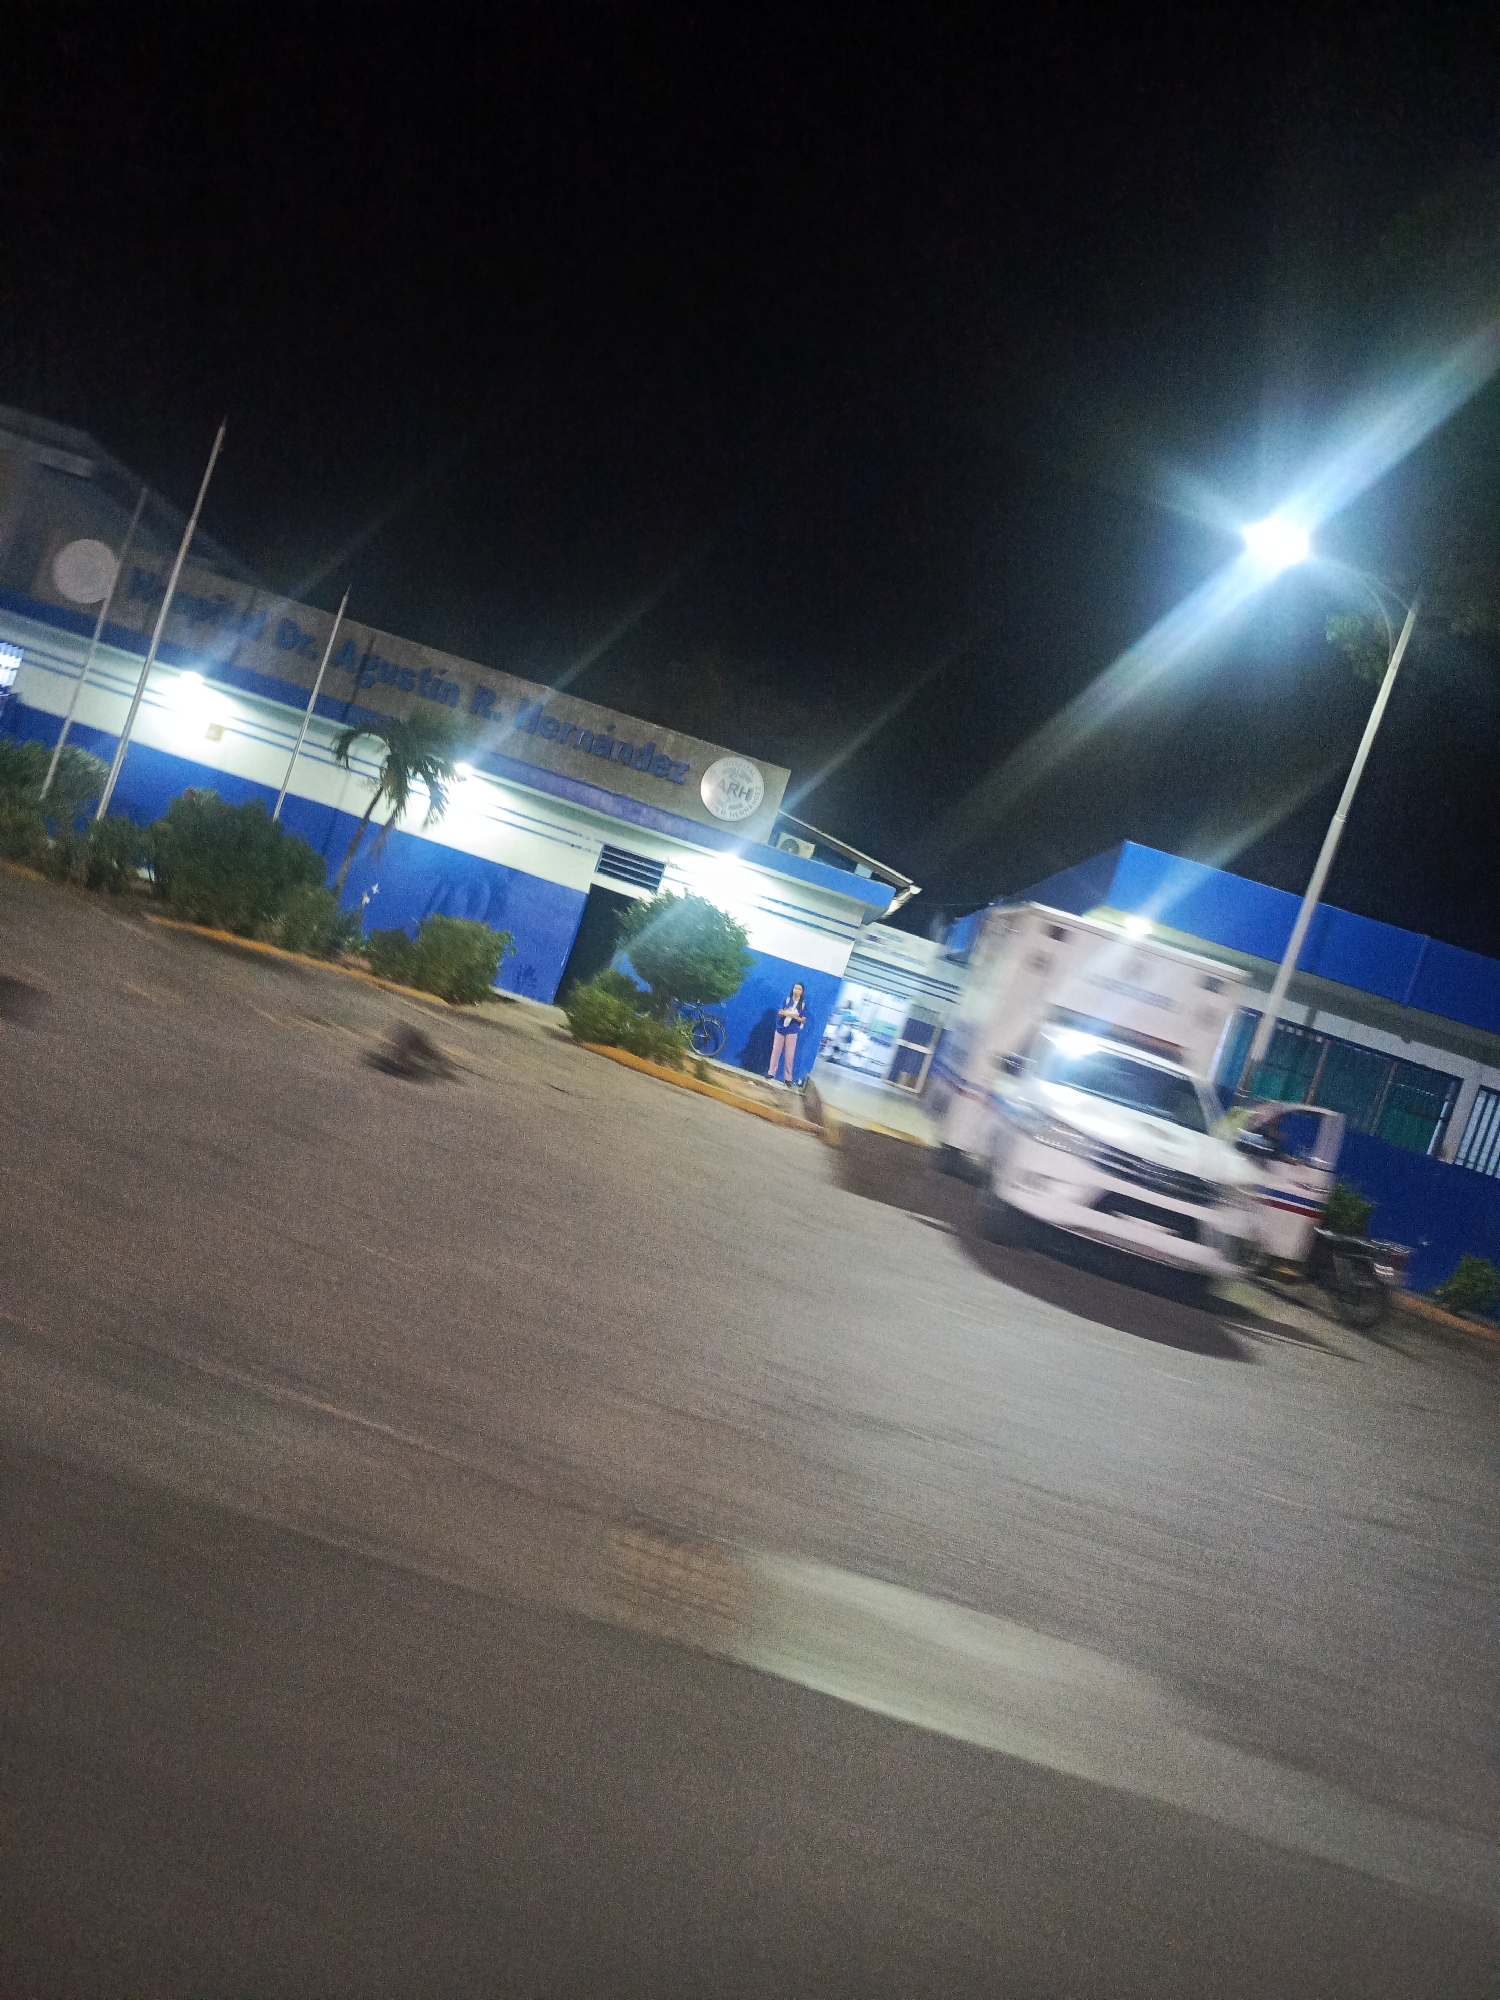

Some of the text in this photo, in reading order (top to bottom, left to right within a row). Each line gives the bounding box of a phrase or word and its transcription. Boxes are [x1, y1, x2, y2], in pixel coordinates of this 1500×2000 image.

[275, 617, 317, 660] Dr.
[331, 638, 461, 708] Agustín
[469, 684, 502, 723] R.
[513, 698, 691, 786] Hernández
[715, 778, 754, 802] ARH
